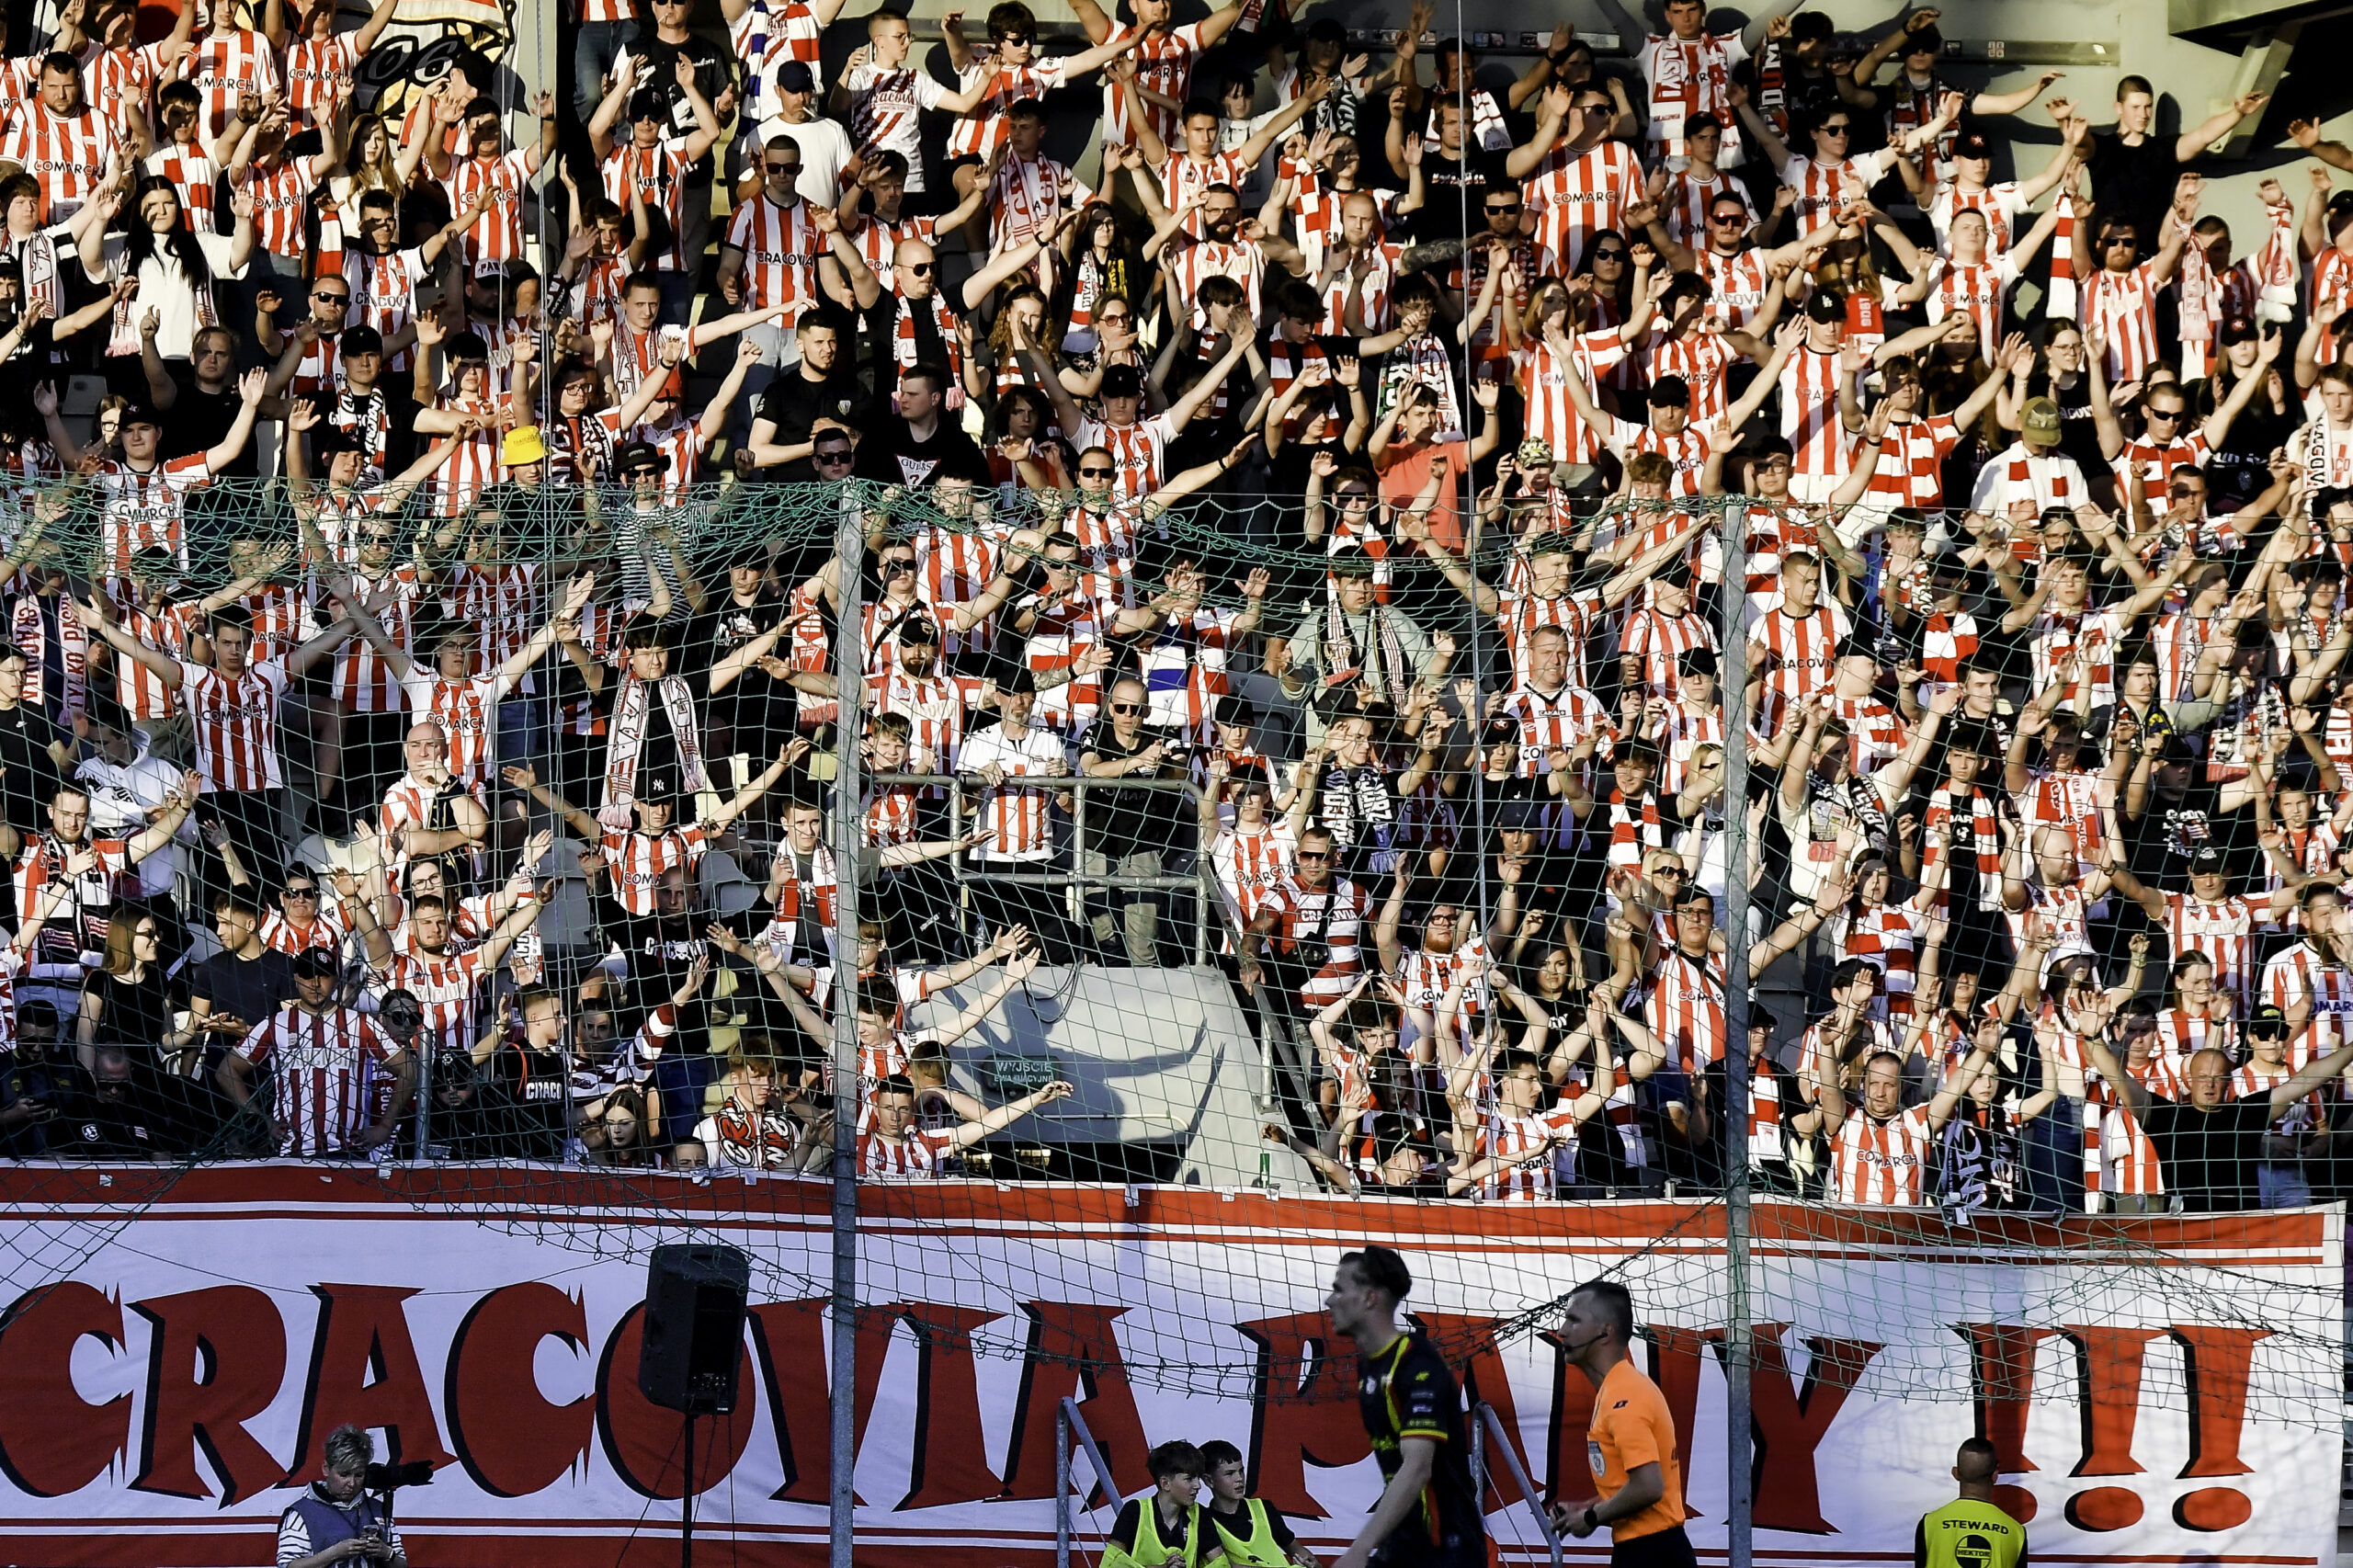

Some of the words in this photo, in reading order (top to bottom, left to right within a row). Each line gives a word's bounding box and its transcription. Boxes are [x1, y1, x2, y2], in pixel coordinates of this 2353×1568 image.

[34, 160, 101, 176] COMARCH
[756, 251, 814, 267] CRACOVIA
[901, 459, 933, 472] GUESS
[202, 704, 268, 722] COMARCH
[1857, 1150, 1918, 1168] COMARCH
[0, 1280, 1158, 1514] CRACOVIA
[1942, 1519, 2009, 1535] STEWARD
[1958, 1548, 1990, 1558] HEKTOR
